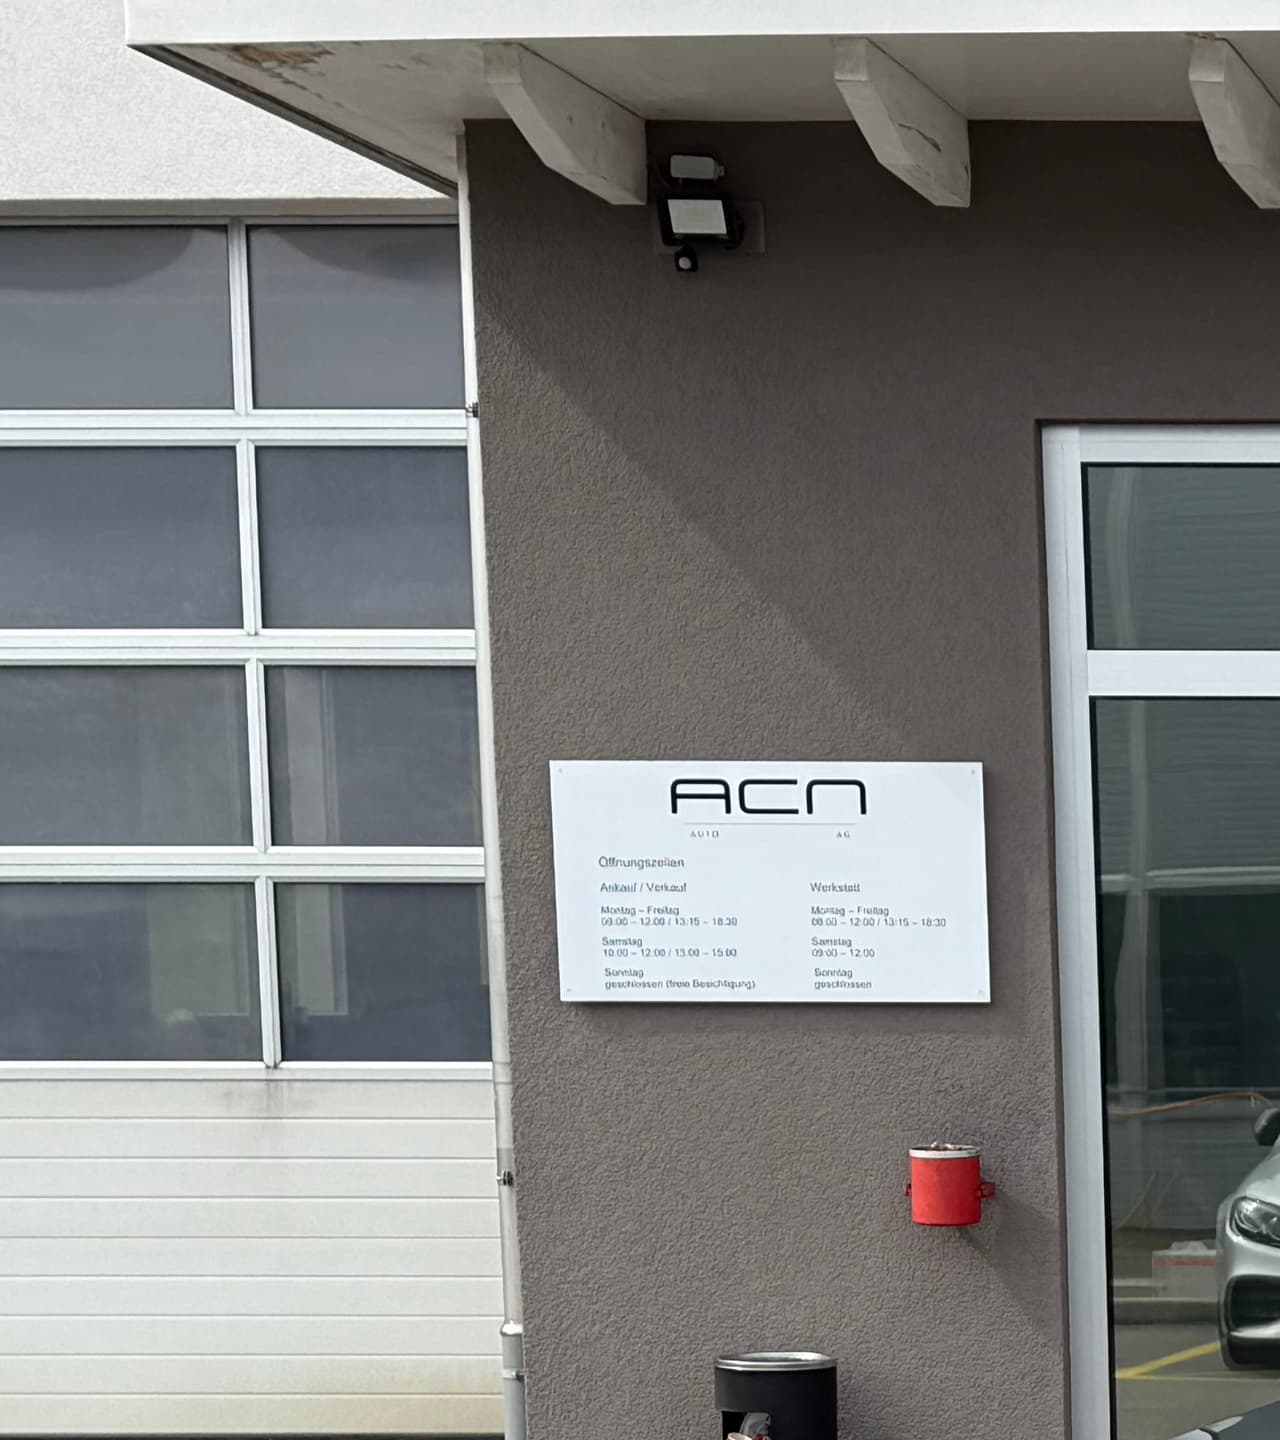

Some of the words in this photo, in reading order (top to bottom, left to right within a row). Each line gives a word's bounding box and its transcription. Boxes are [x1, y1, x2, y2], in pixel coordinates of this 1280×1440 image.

[670, 778, 867, 815] ACN
[600, 883, 637, 892] Ankauf
[646, 882, 686, 892] Verkauf
[810, 883, 860, 892] Werkstatt
[601, 906, 636, 916] Montag
[647, 906, 679, 916] Freitag
[857, 906, 889, 916] Freitag
[602, 937, 642, 947] Samstag
[811, 937, 852, 947] Samstag
